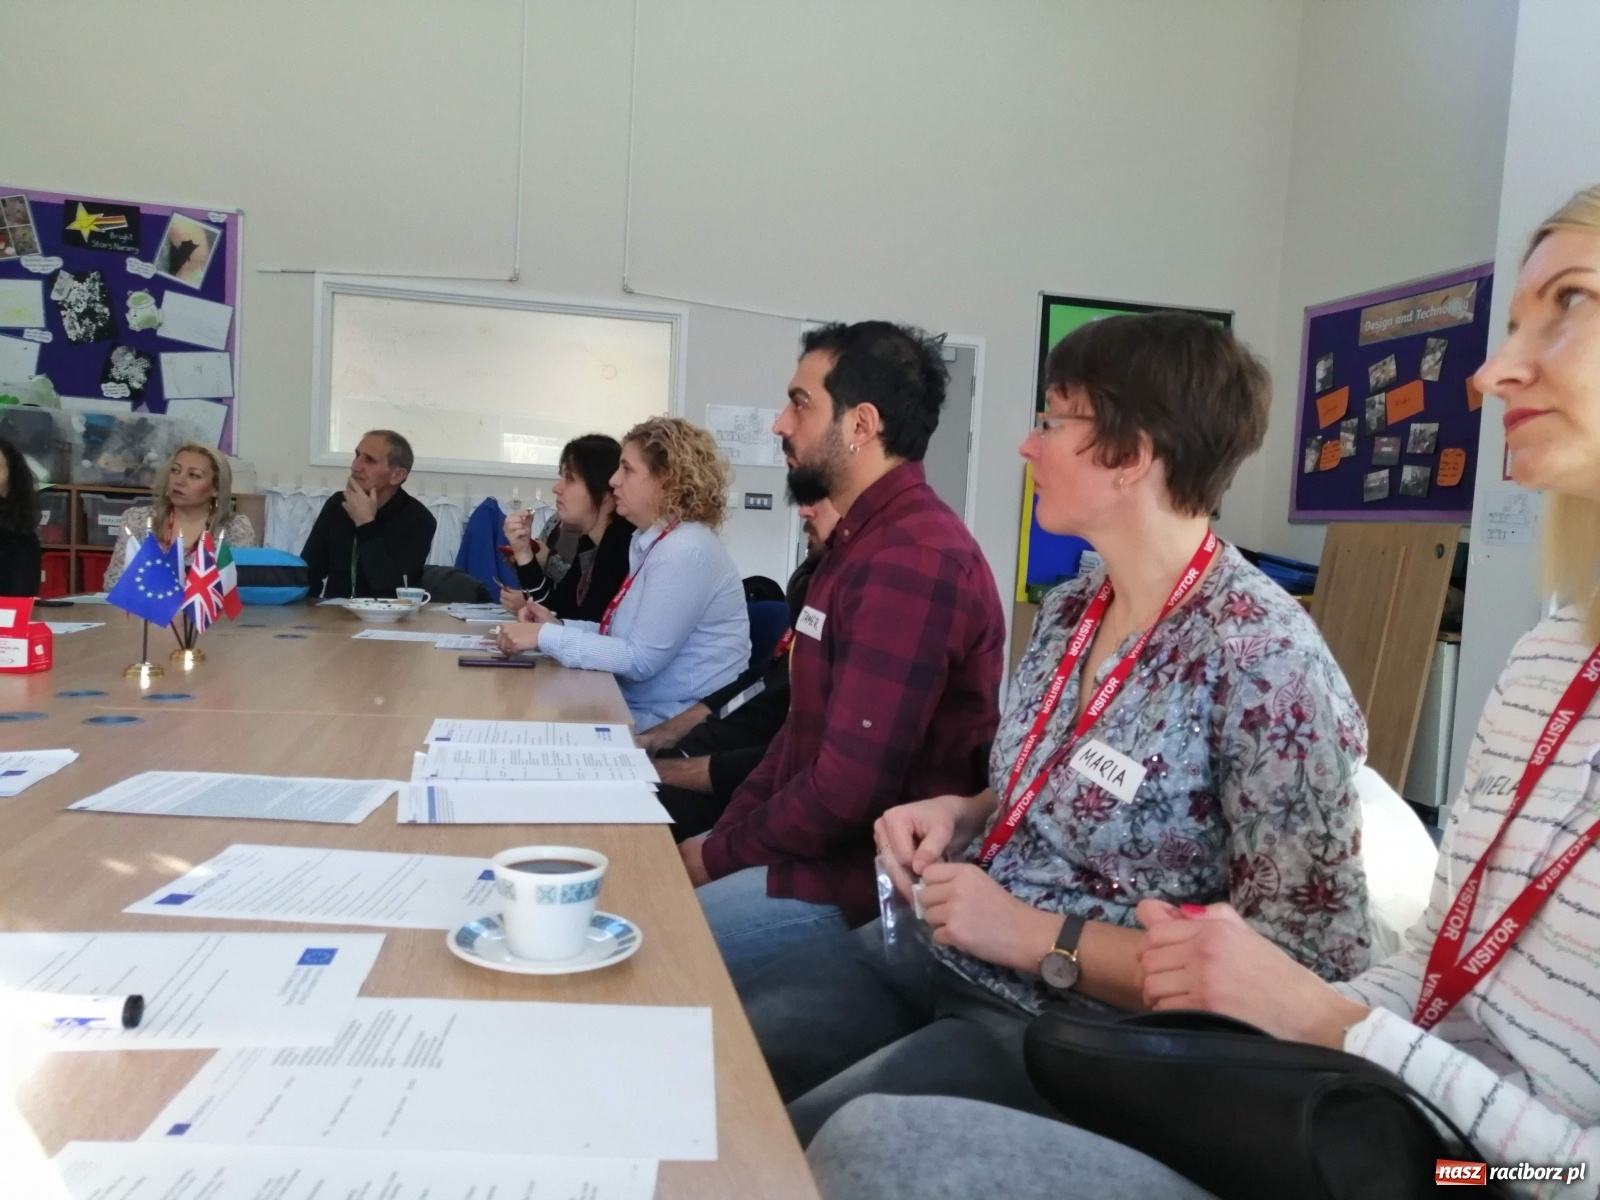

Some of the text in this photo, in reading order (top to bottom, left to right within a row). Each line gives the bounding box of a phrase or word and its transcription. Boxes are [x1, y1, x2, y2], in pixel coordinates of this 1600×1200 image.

[91, 239, 140, 255] Stars Nursery
[109, 231, 134, 244] Bright
[1364, 316, 1393, 332] Design
[1395, 310, 1413, 324] and
[1167, 568, 1200, 607] VISITOR
[1068, 618, 1095, 656] VISITOR
[1041, 675, 1066, 714] VISITOR
[1087, 677, 1120, 717] VISITOR
[1015, 734, 1037, 773] VISITOR
[1530, 709, 1576, 766] VISITOR
[1079, 747, 1127, 788] MARIA
[1005, 790, 1035, 827] VISITOR
[1535, 834, 1592, 891] VISITOR
[1443, 879, 1478, 941] VISITOR
[1462, 917, 1520, 975] VISITOR
